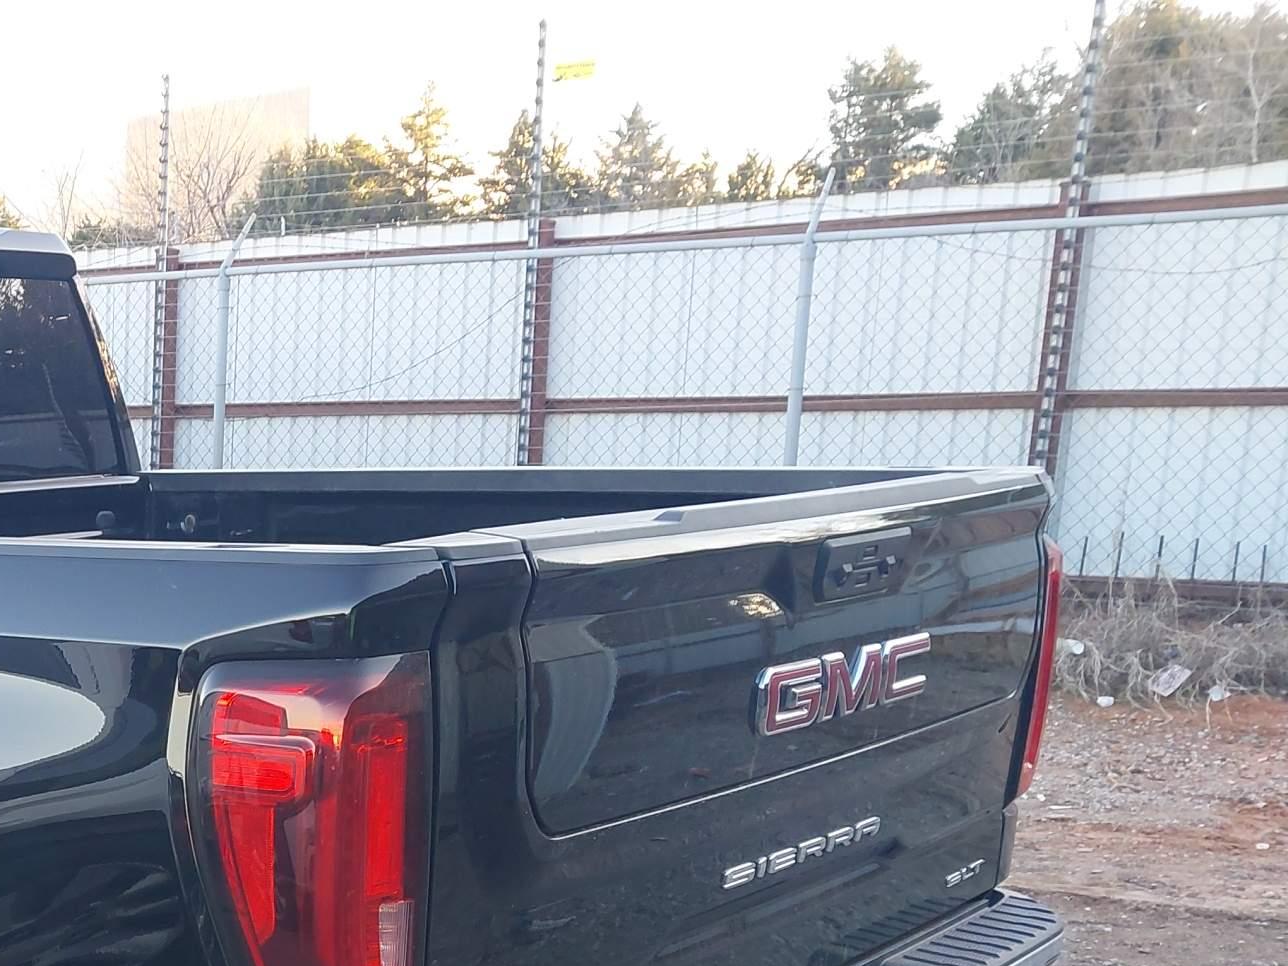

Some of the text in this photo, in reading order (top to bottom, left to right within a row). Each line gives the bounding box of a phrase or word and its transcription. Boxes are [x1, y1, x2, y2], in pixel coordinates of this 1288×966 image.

[755, 632, 931, 736] GMC
[720, 816, 881, 890] SIERRA
[944, 858, 986, 888] SLT
